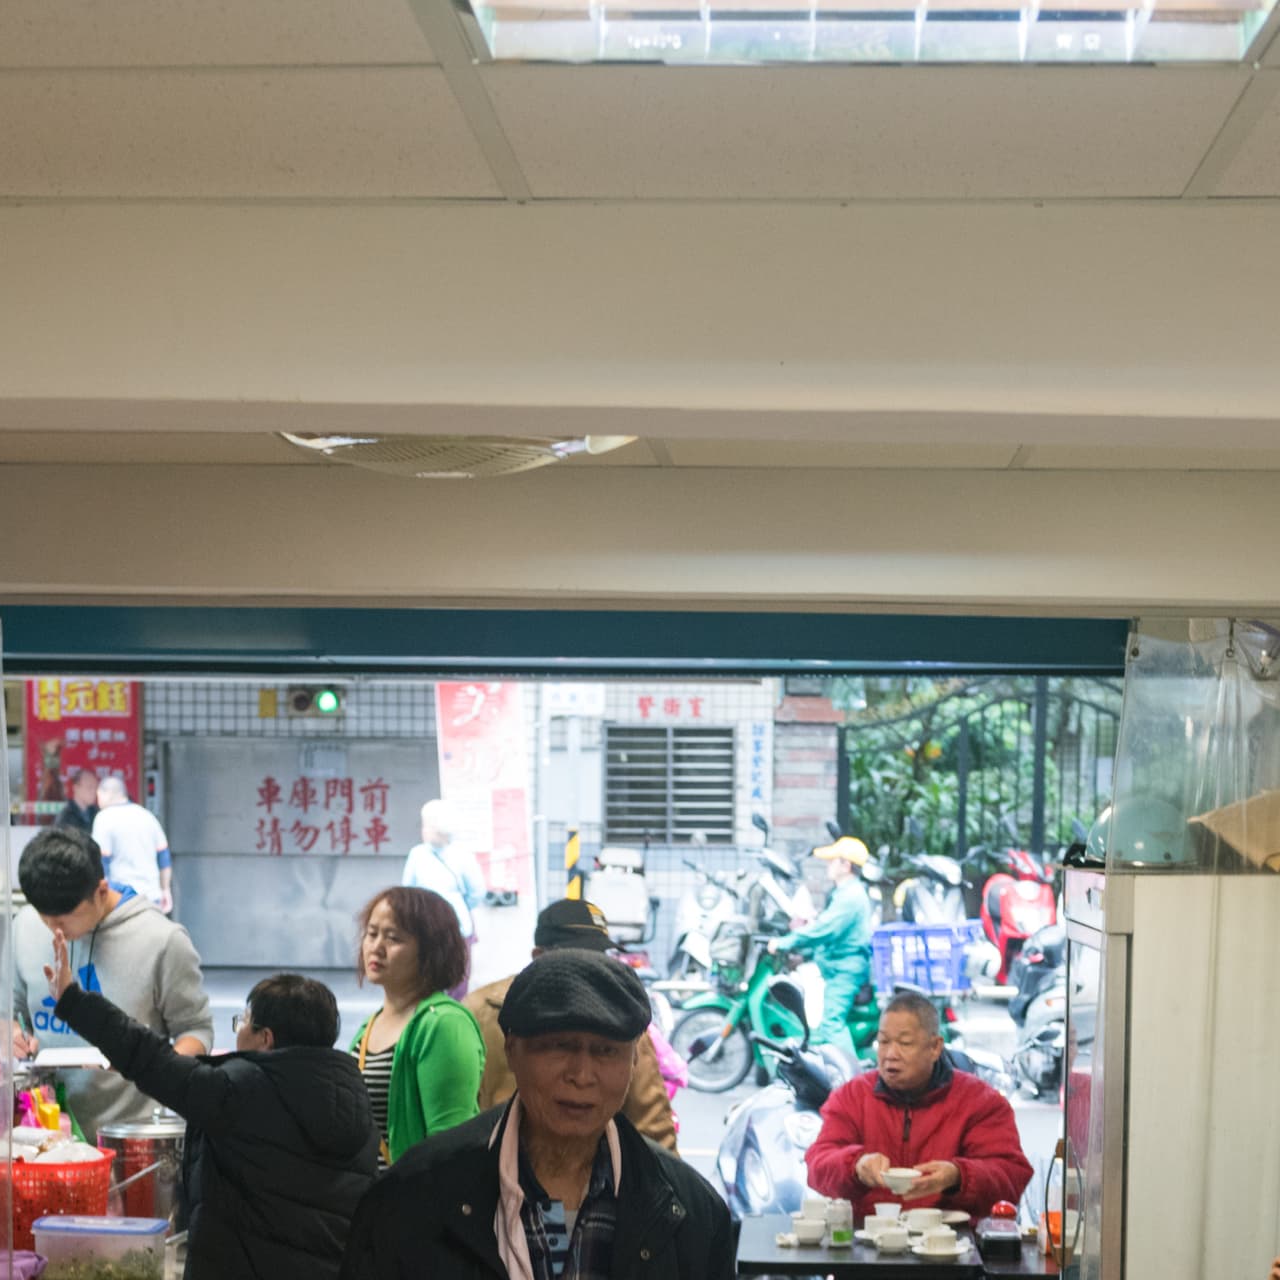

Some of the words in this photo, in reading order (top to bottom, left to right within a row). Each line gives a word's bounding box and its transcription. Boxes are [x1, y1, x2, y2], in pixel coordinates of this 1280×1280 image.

[636, 695, 705, 719] 警衛室
[255, 776, 391, 815] 車庫門前
[255, 816, 391, 856] 請勿停車
